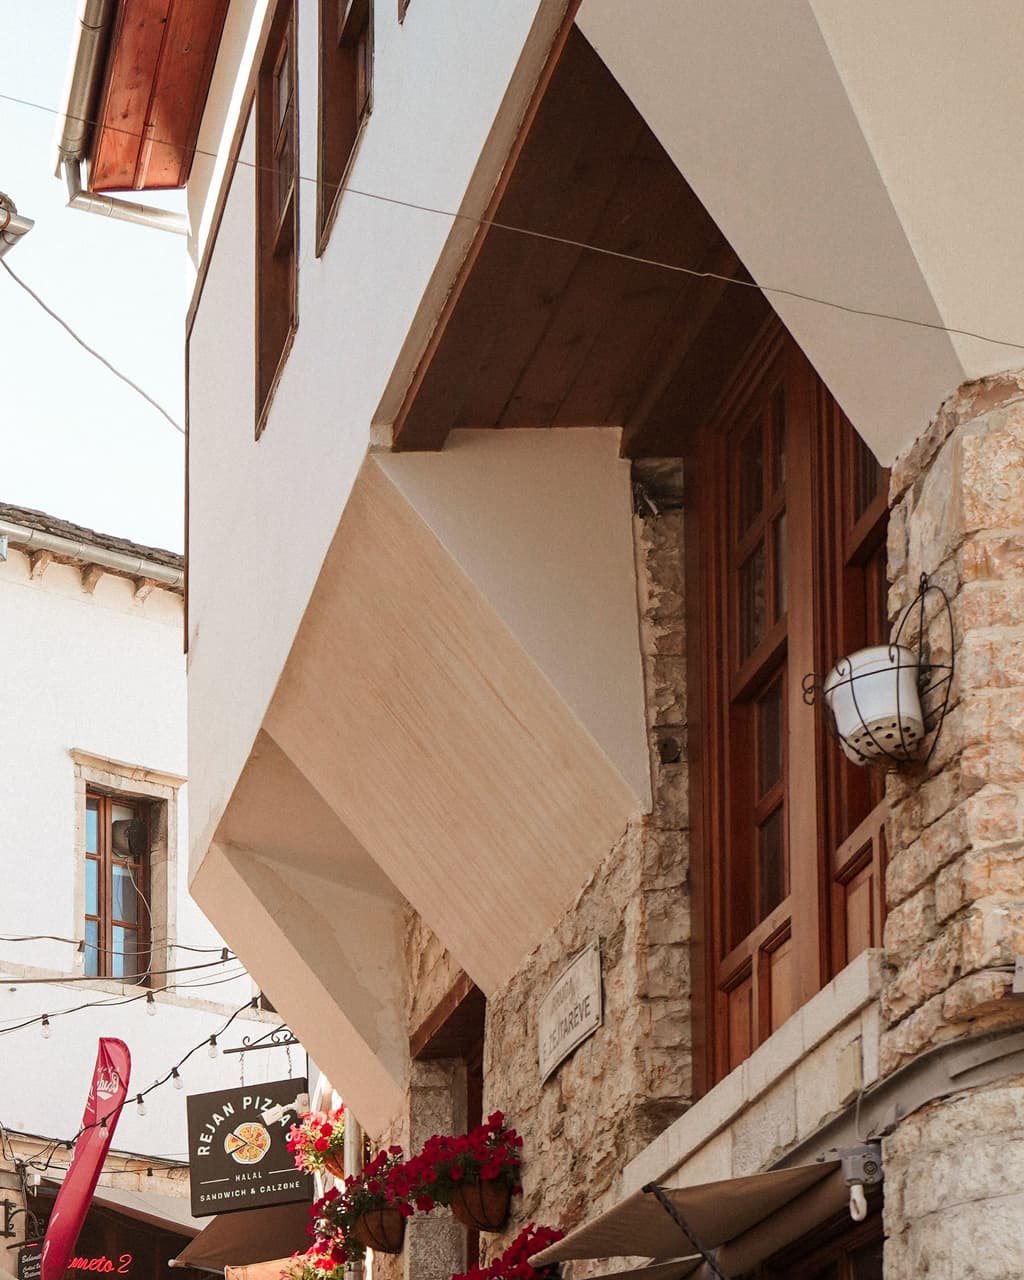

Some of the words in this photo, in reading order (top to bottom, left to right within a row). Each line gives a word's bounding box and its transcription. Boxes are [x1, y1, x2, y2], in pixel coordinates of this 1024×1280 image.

[197, 1102, 235, 1156] REJAN
[242, 1096, 294, 1143] PIZA
[235, 1171, 263, 1182] HALAL
[199, 1188, 247, 1202] SANDWICH
[250, 1187, 256, 1195] &
[259, 1181, 301, 1193] CALZONE
[68, 1255, 115, 1273] meto
[117, 1253, 133, 1274] 2
